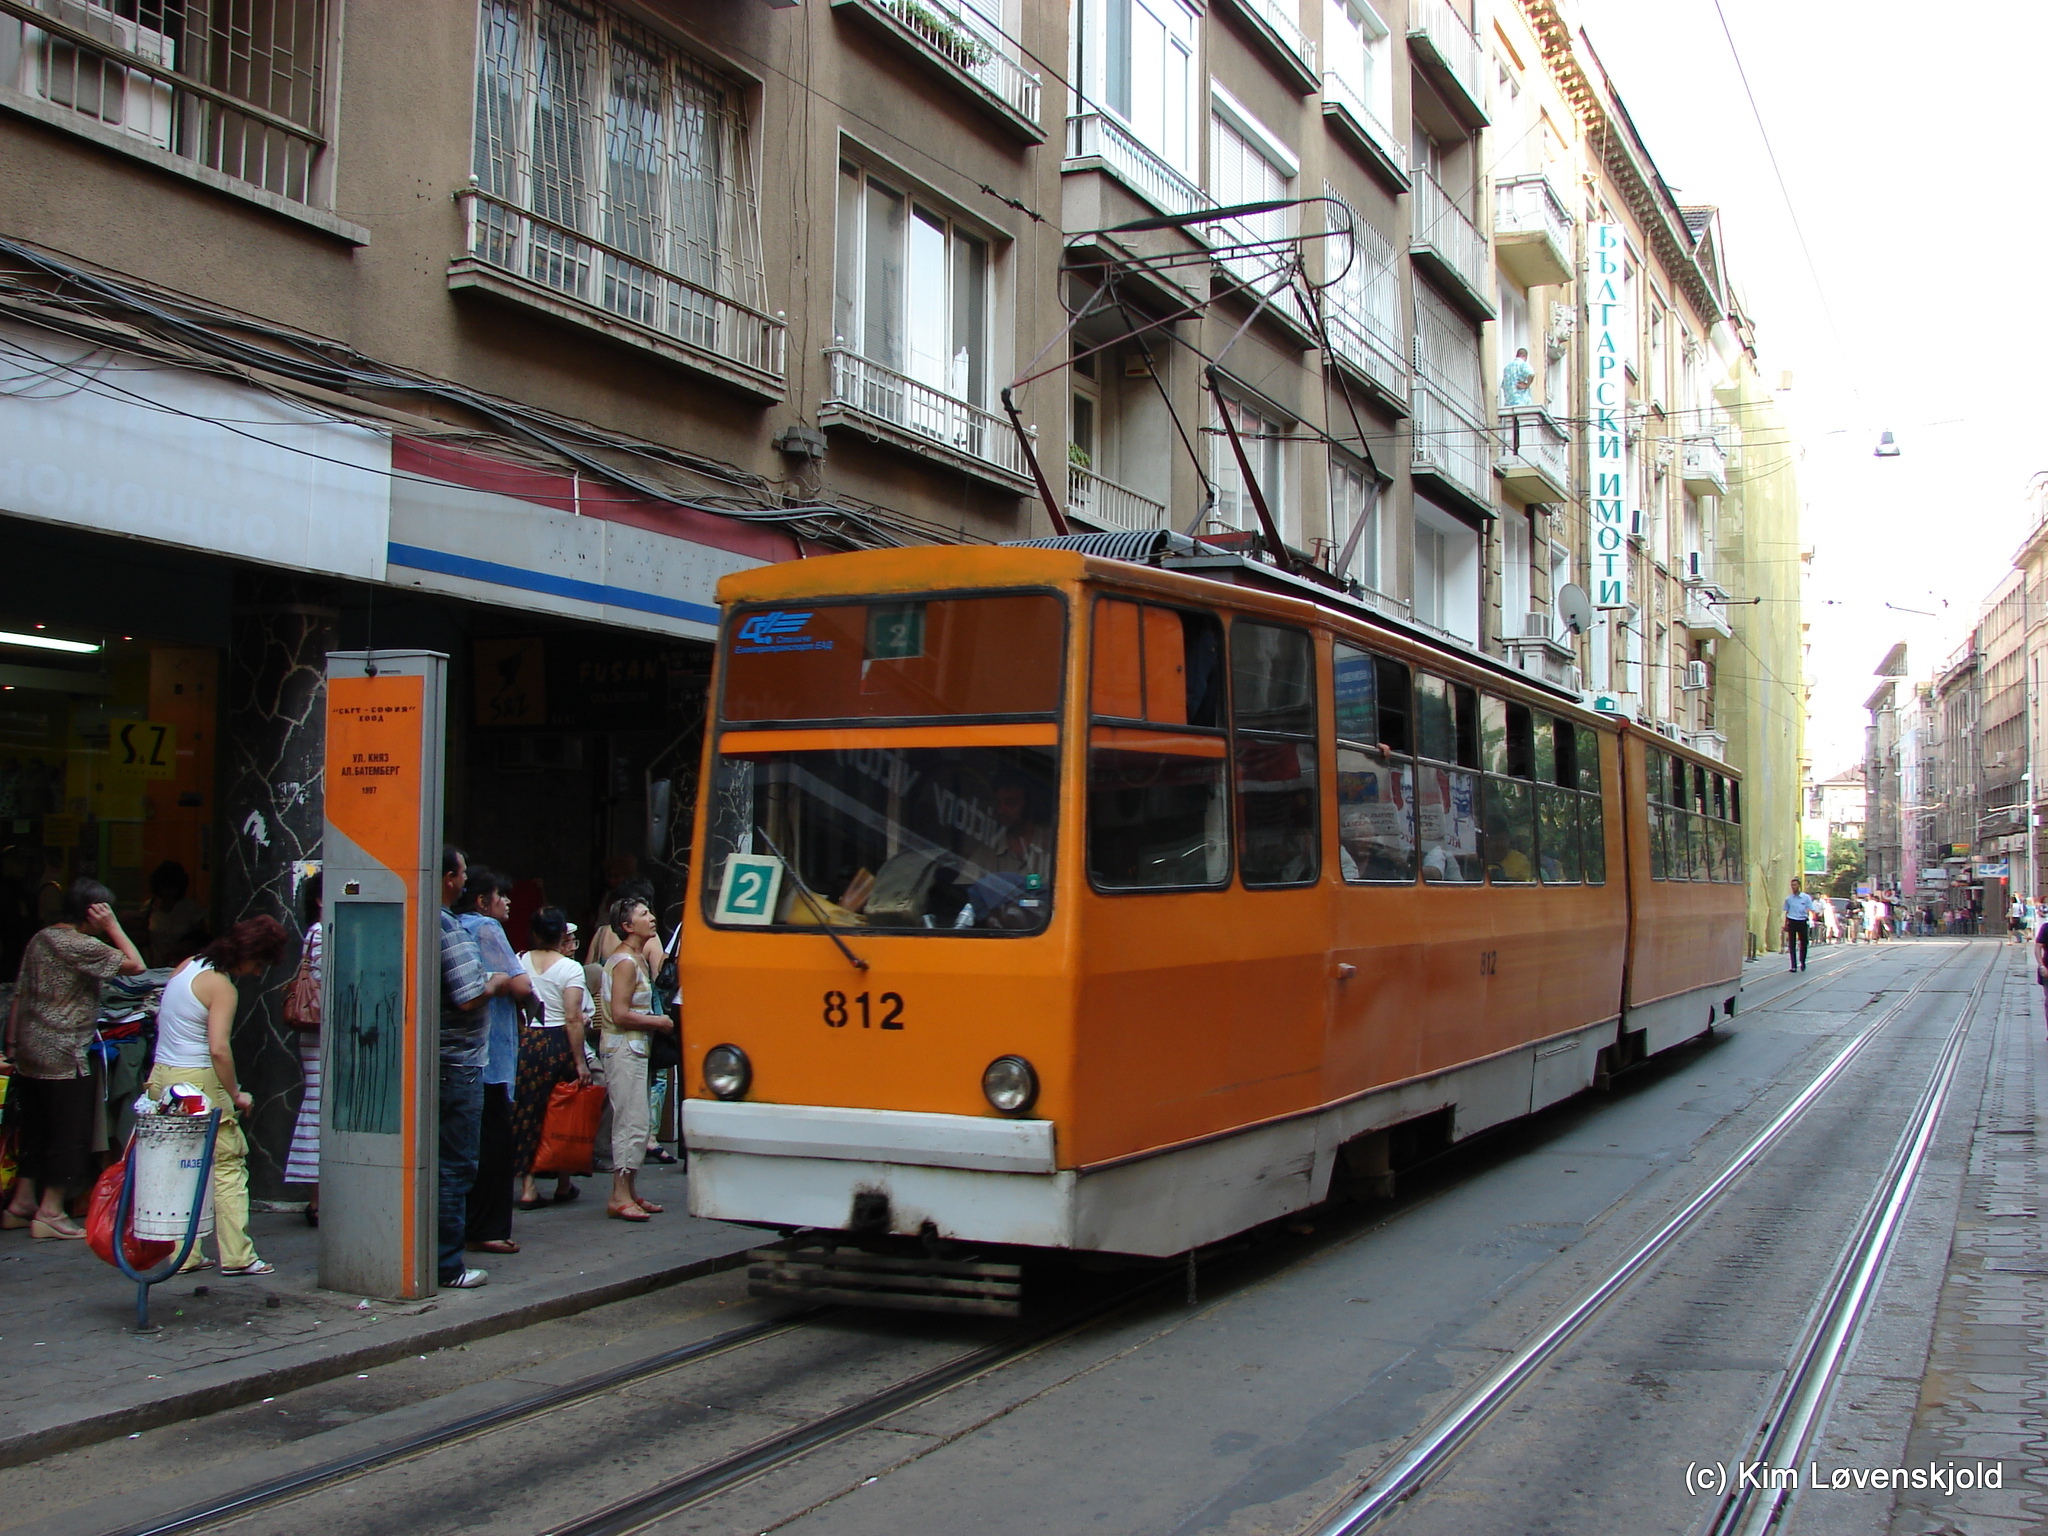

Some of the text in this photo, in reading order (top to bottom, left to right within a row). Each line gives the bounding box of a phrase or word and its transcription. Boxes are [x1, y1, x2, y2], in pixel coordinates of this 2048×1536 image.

[1595, 225, 1622, 605] БЪЛГАРСКИ ИМОТИ
[889, 623, 907, 648] 2
[353, 752, 389, 763] УЛ. КНЯЗ
[733, 871, 762, 908] 2
[1480, 950, 1498, 976] 812
[822, 990, 906, 1031] 812
[180, 1159, 203, 1169] ПАЗЕ
